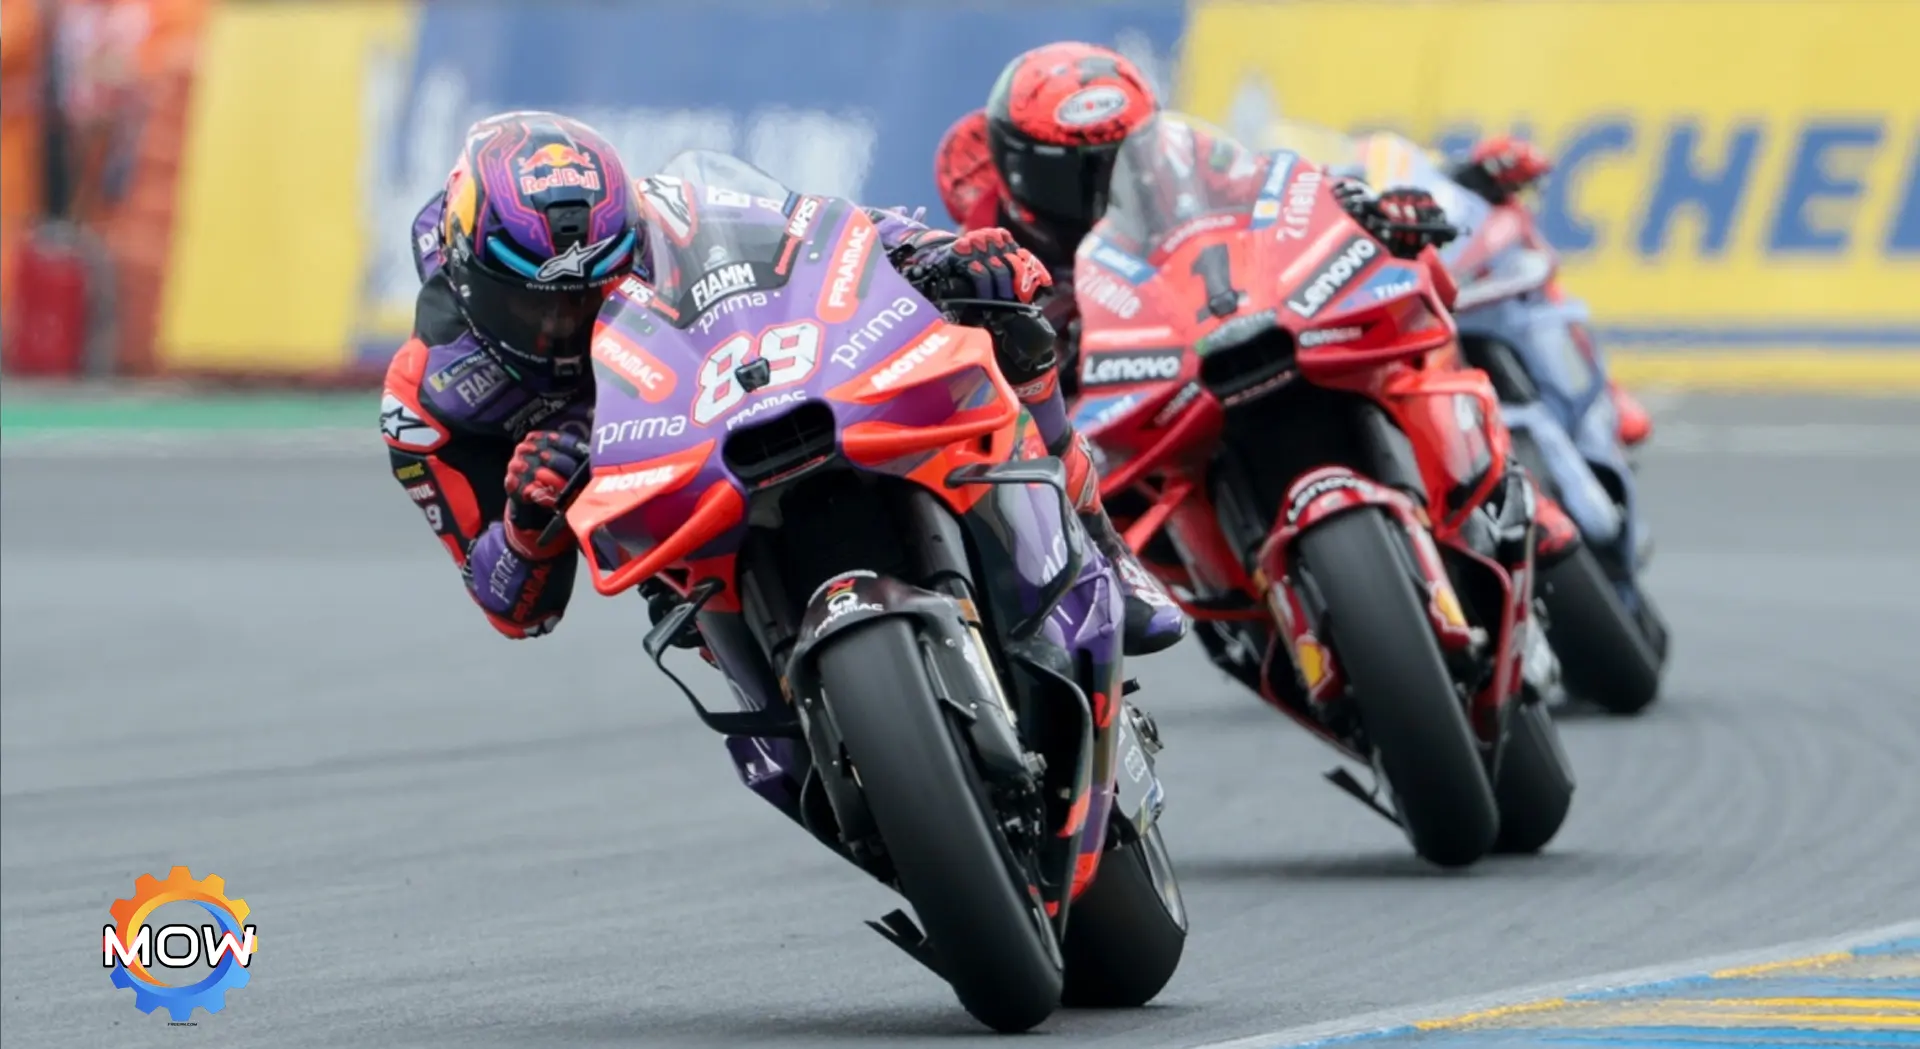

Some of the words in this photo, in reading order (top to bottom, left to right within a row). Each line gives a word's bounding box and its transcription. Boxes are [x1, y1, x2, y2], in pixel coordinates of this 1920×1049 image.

[520, 168, 562, 195] Red
[562, 168, 600, 190] Bull
[691, 263, 756, 310] FIAMM
[828, 226, 871, 308] PRAMAC
[1191, 243, 1247, 323] 1
[1287, 238, 1376, 318] Lenovo
[699, 291, 768, 335] prima
[831, 297, 918, 370] prima
[597, 337, 665, 390] PRAMAC
[691, 320, 823, 428] 89
[870, 332, 950, 390] MOTUL
[1082, 355, 1181, 383] Lenovo
[596, 415, 687, 455] prima
[726, 390, 808, 431] PRAMAC
[594, 465, 674, 493] MOTUL
